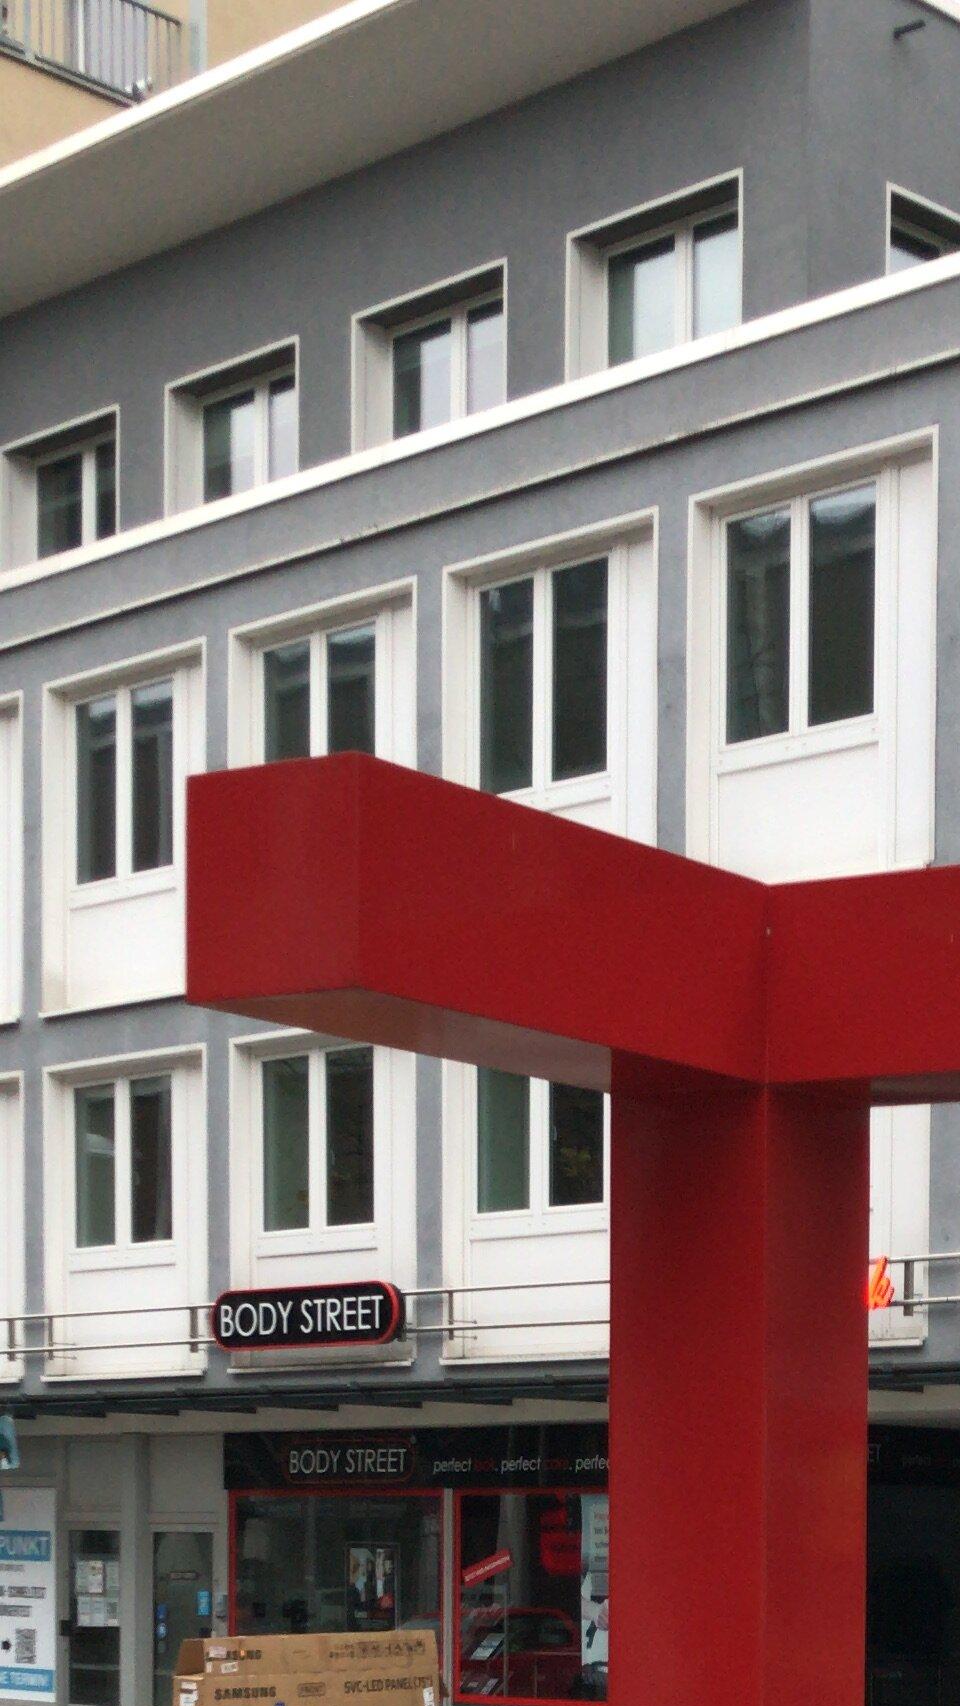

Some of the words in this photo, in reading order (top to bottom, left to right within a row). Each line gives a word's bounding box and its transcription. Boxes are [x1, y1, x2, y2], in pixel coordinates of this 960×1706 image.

[220, 1300, 293, 1338] BODY
[300, 1295, 384, 1334] STREET
[288, 1449, 341, 1474] BODY
[344, 1448, 407, 1473] STREET
[433, 1457, 472, 1474] perfect
[501, 1456, 542, 1474] perfect
[575, 1454, 609, 1473] perfe
[214, 1686, 277, 1700] SAMSUNG
